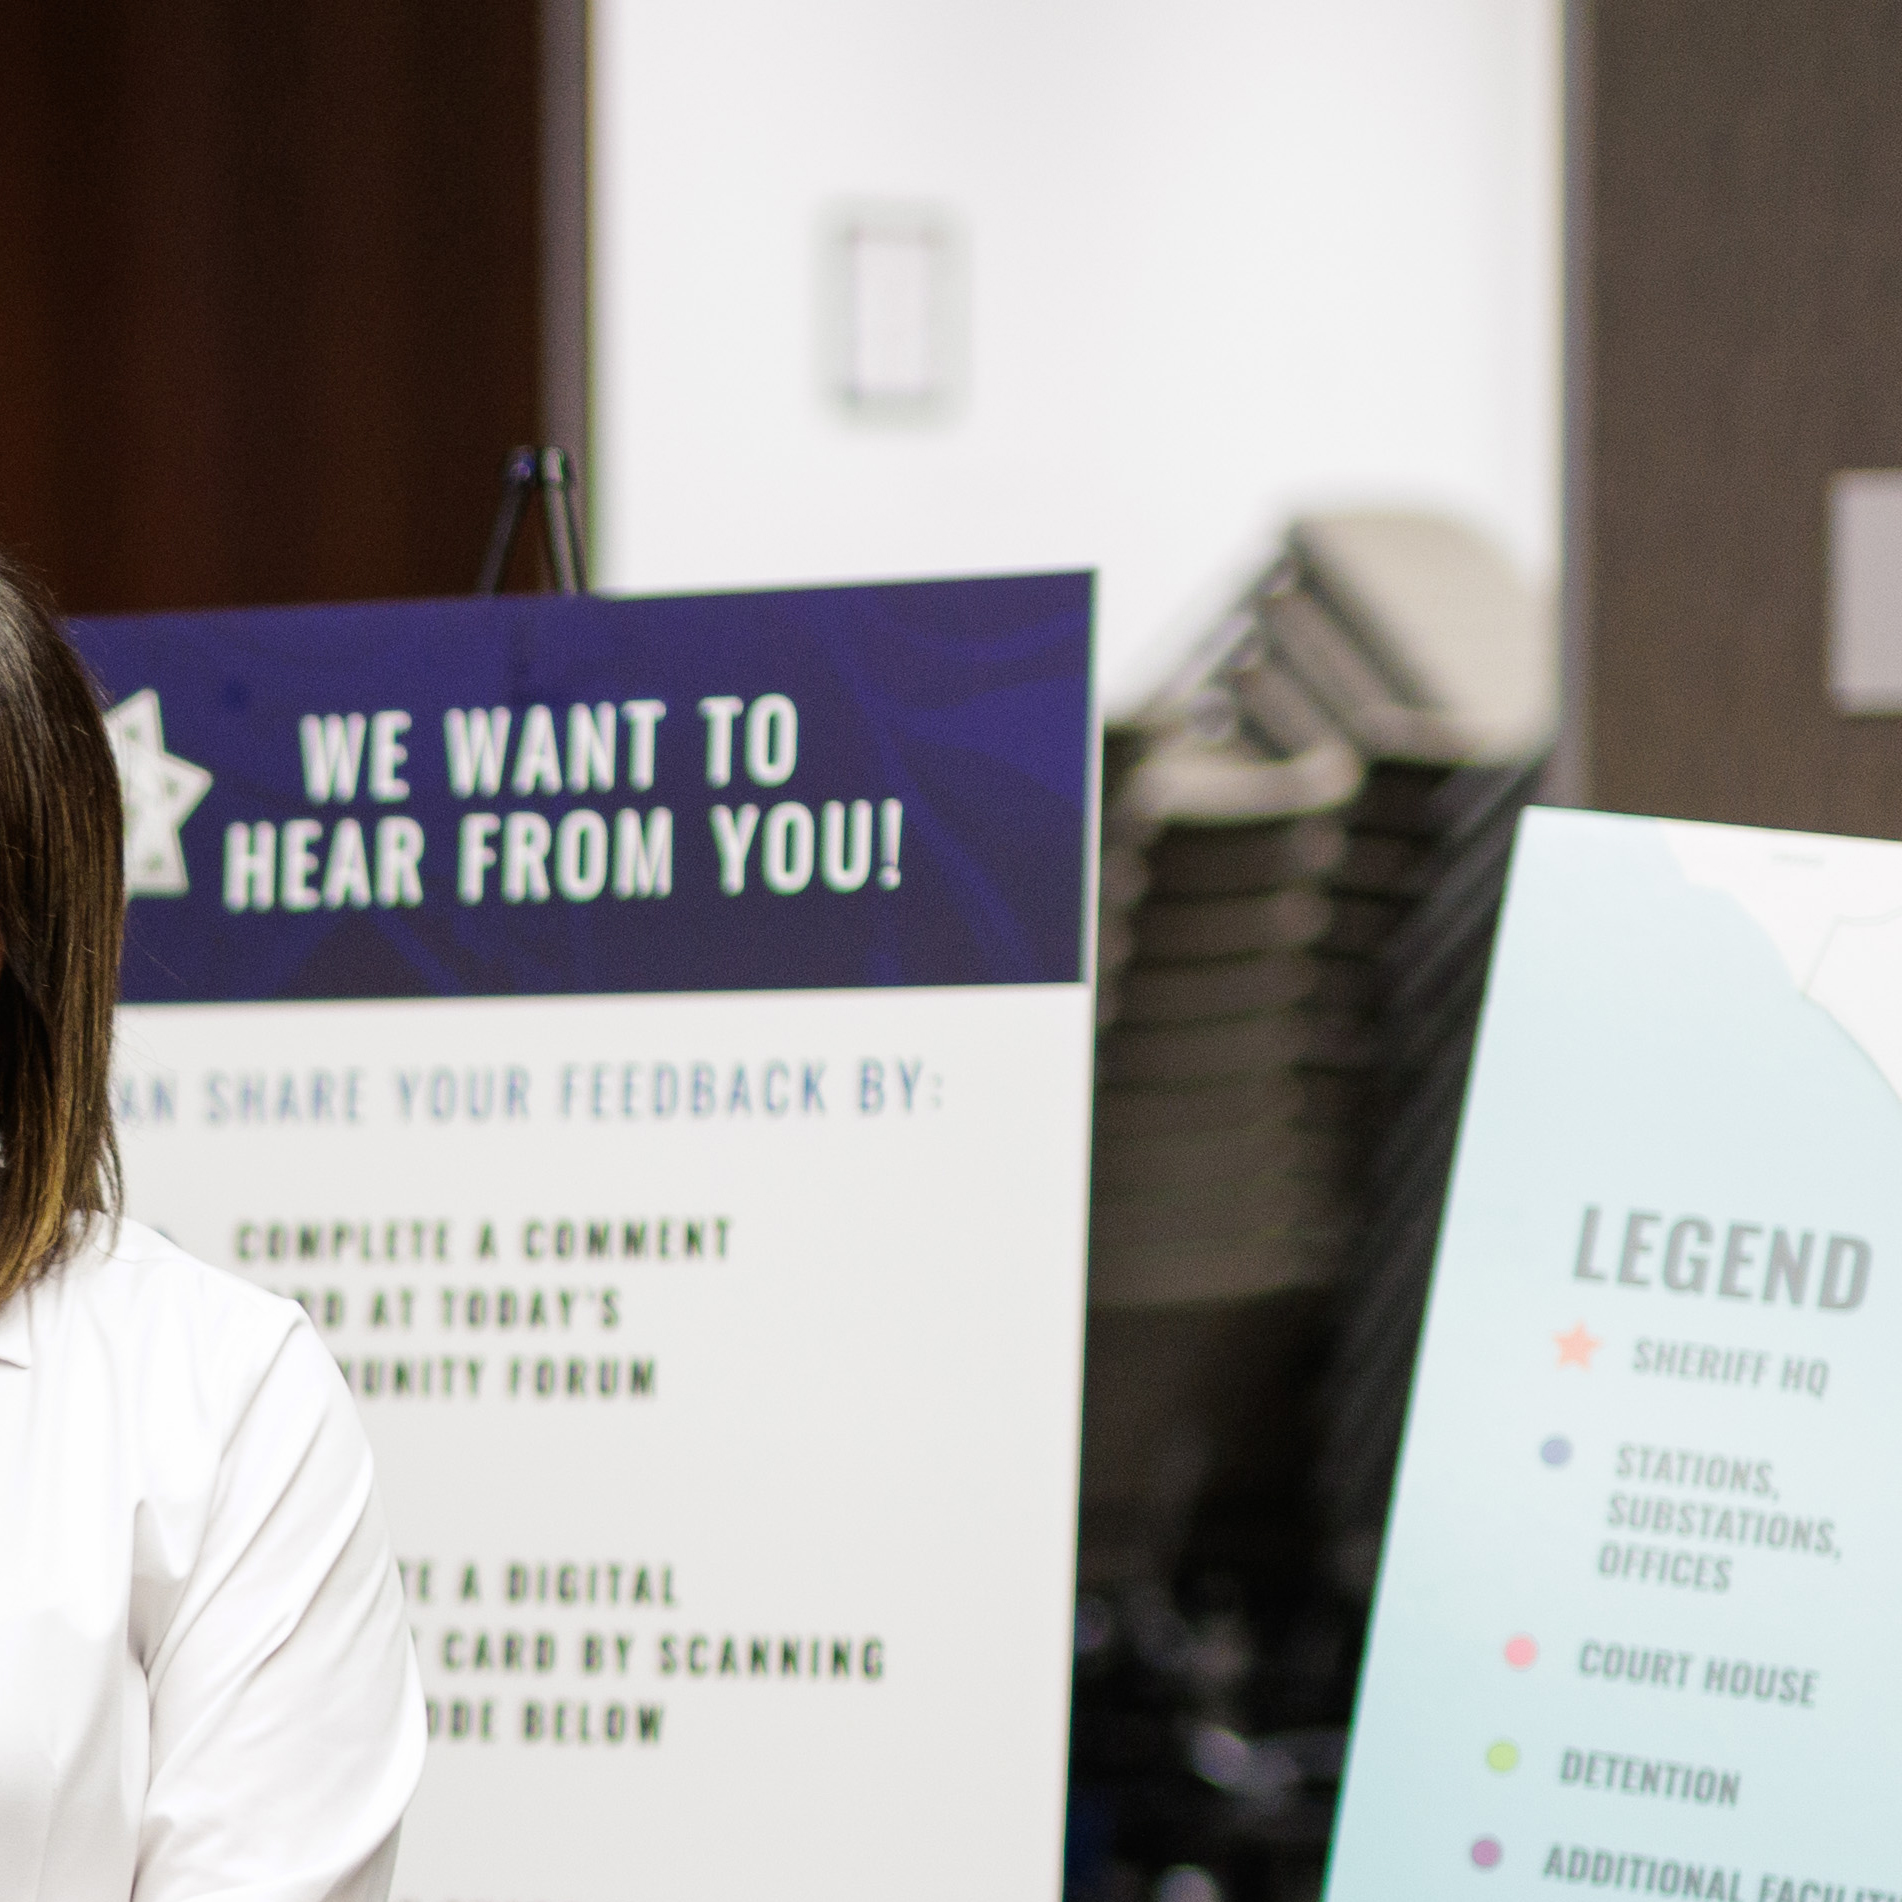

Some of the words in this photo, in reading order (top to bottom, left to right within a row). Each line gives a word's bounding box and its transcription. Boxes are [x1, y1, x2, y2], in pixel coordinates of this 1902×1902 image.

[299, 711, 412, 803] WE
[444, 699, 666, 798] WANT
[697, 692, 799, 788] TO
[223, 817, 425, 912] HEAR
[457, 807, 673, 905] FROM
[710, 798, 902, 896] YOU!
[120, 1070, 178, 1123] AN
[205, 1068, 364, 1125] SHARE
[396, 1064, 532, 1122] YOUR
[559, 1058, 826, 1120] FEEDBACK
[859, 1054, 943, 1114] BY:
[235, 1220, 448, 1260] COMPLETE
[478, 1220, 497, 1258] A
[523, 1217, 730, 1259] COMMENT
[1573, 1205, 1873, 1314] LEGEND
[370, 1288, 414, 1329] AT
[442, 1286, 622, 1330] TODAY'S
[509, 1356, 657, 1397] FORUM
[1632, 1338, 1771, 1388] SHERIFF
[1779, 1356, 1830, 1401] HQ
[1616, 1442, 1781, 1500] STATIONS,
[1605, 1493, 1842, 1561] SUBSTATIONS,
[461, 1562, 480, 1601] A
[508, 1561, 678, 1606] DIGITAL
[1597, 1543, 1734, 1594] OFFICES
[443, 1631, 556, 1671] CARD
[582, 1632, 633, 1674] BY
[659, 1634, 884, 1681] SCANNING
[1578, 1639, 1692, 1692] COURT
[1702, 1655, 1820, 1708] HOUSE
[524, 1702, 664, 1743] BELOW
[1559, 1747, 1741, 1806] DETENTION
